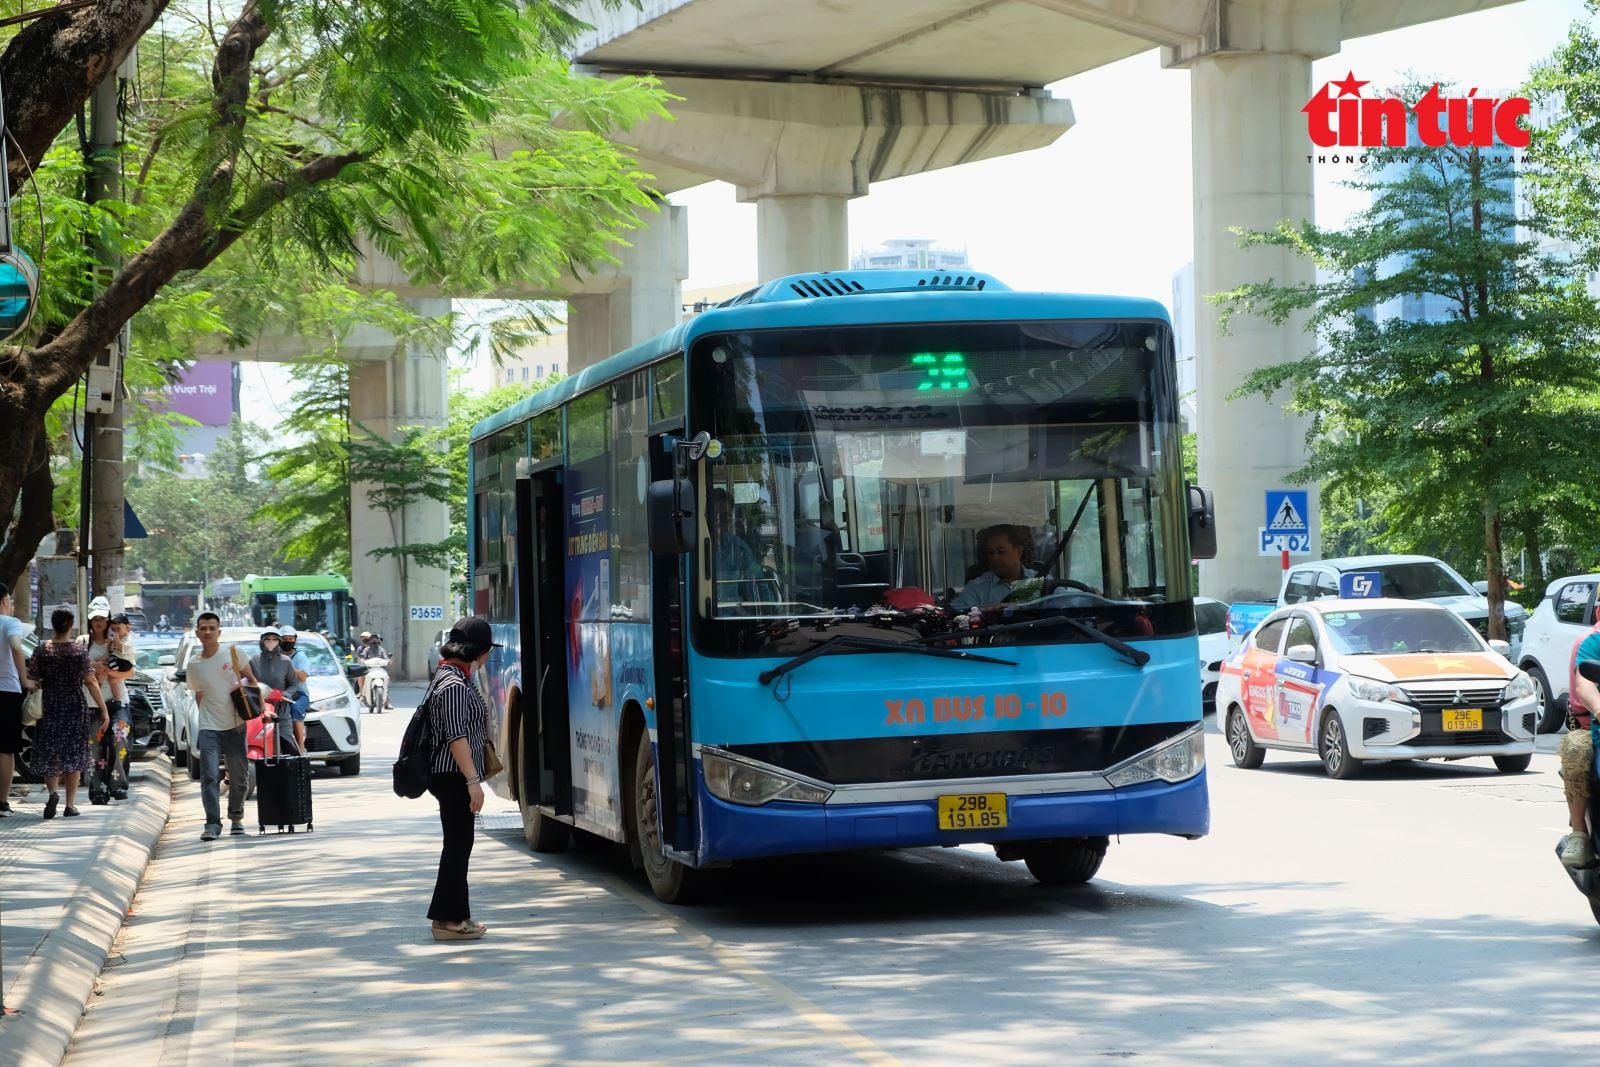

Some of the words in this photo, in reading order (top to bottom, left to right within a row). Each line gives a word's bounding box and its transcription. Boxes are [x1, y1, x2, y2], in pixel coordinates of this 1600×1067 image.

[174, 384, 197, 395] Vượt
[199, 384, 217, 395] Trội
[1353, 575, 1372, 597] G7
[411, 607, 442, 619] P365R
[933, 696, 985, 723] BUS
[994, 693, 1021, 720] 10
[1041, 691, 1067, 717] 10
[1454, 710, 1471, 720] 29E
[957, 796, 987, 811] 29B
[948, 811, 1001, 828] 191.85
